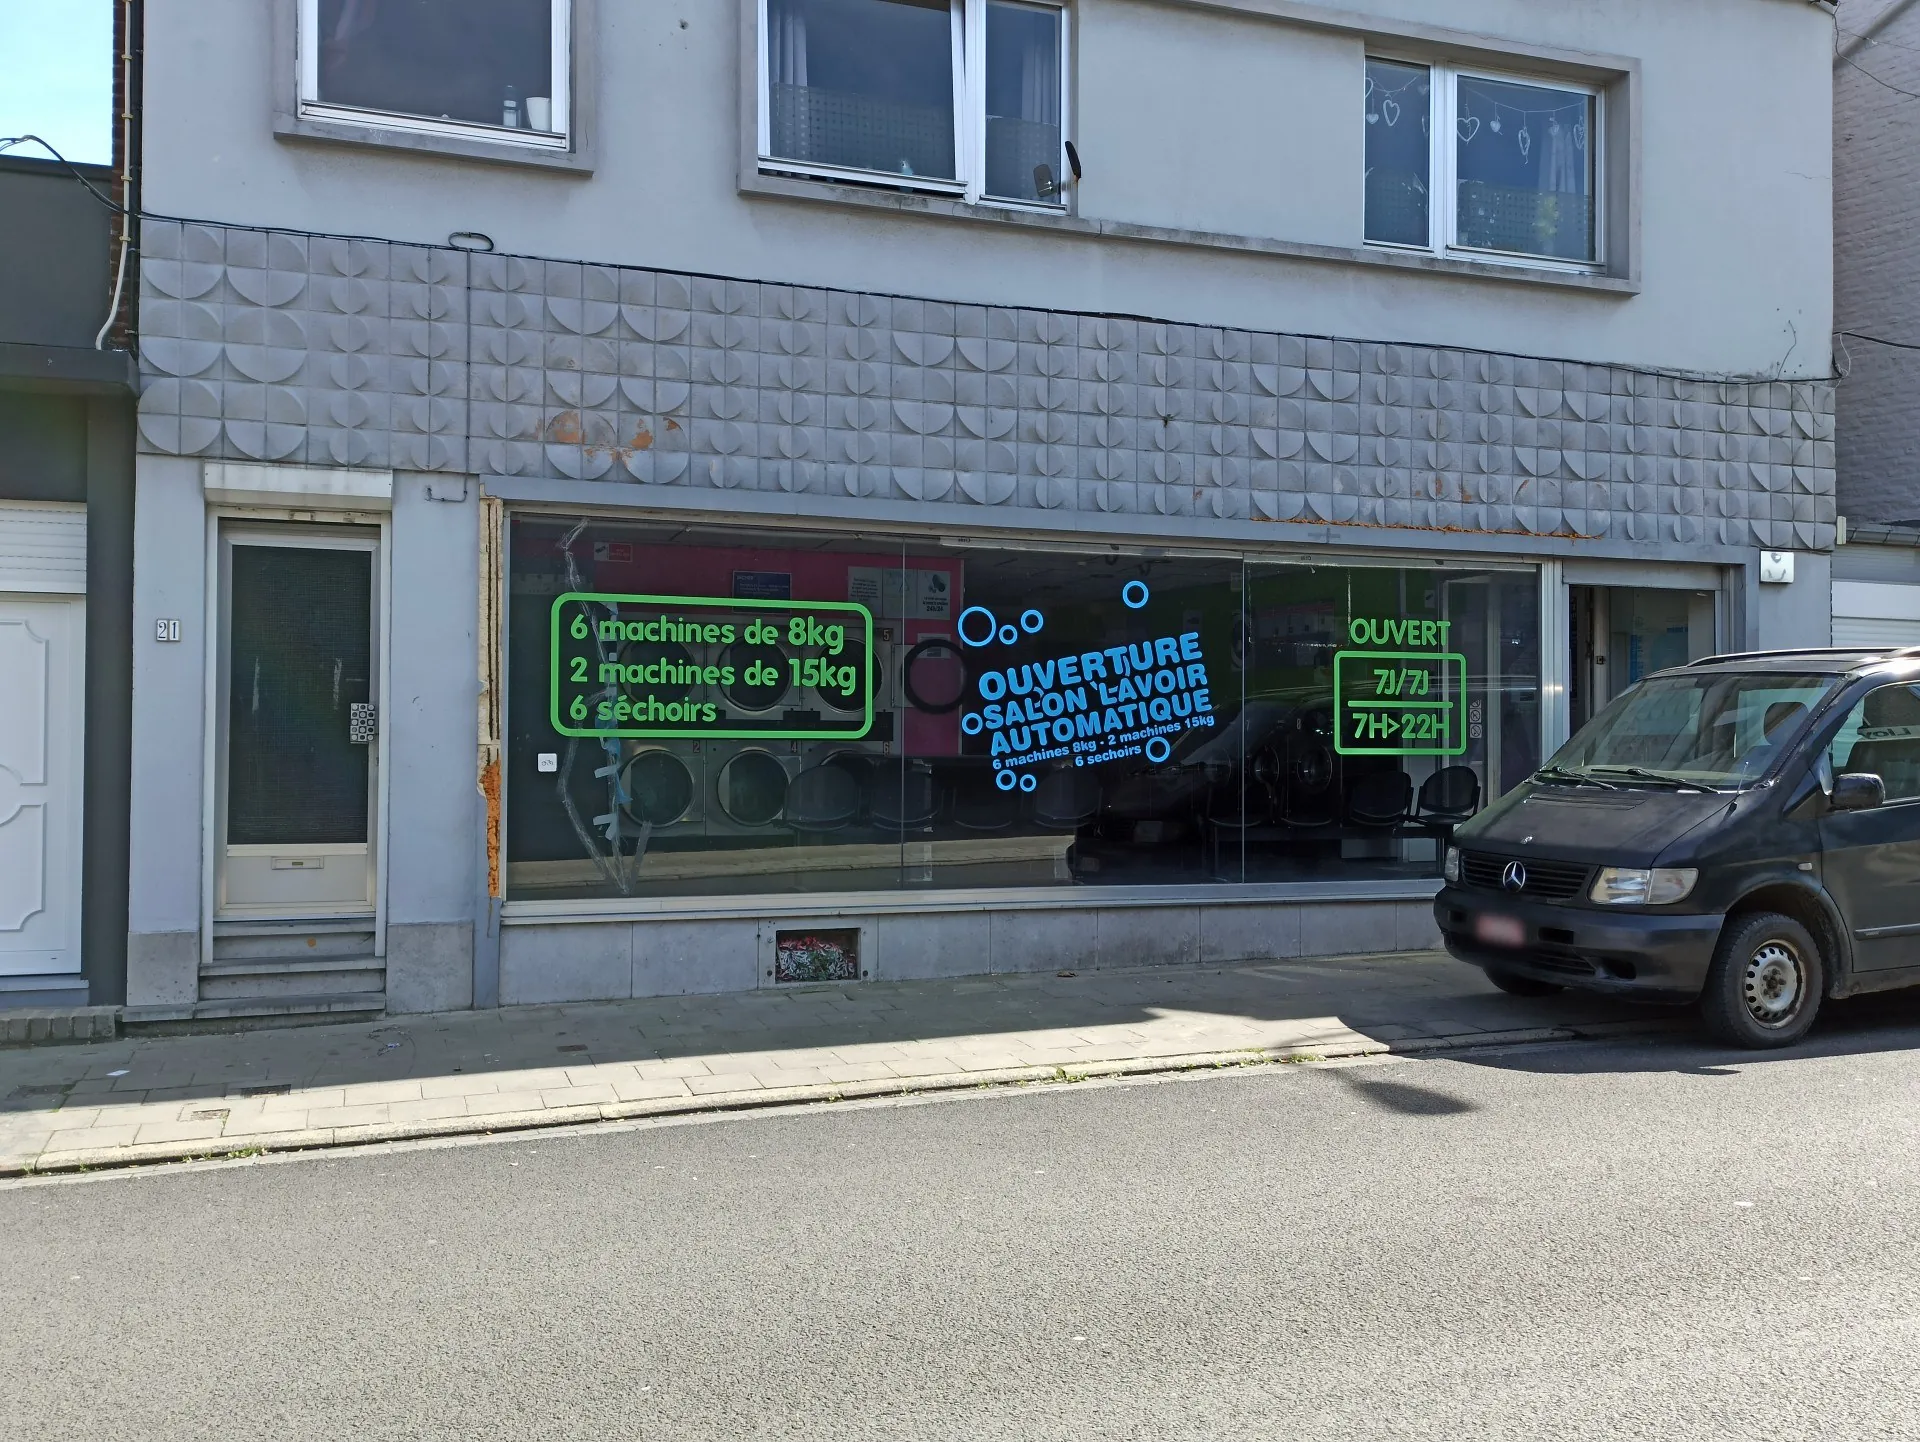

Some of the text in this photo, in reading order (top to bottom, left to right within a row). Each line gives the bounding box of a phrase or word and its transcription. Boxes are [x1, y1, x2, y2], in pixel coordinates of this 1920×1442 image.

[158, 621, 176, 639] 21
[570, 614, 844, 655] 6 machines de 8kg
[1349, 618, 1451, 646] OUVERT
[570, 656, 856, 696] 2 machines de 15kg
[978, 631, 1203, 701] OUVERTURE
[1373, 668, 1429, 696] 7J/7J
[569, 694, 717, 722] 6 séchoirs
[982, 663, 1208, 730] SALON LAVOIR
[990, 688, 1213, 757] AUTOMATIQUE
[1352, 712, 1450, 739] 7H>22H
[992, 759, 1002, 770] 6
[1005, 746, 1069, 768] machines
[1073, 739, 1097, 754] 8kg
[1108, 734, 1116, 745] 2
[1119, 723, 1181, 742] machines
[1185, 714, 1215, 730] 15kg
[1075, 745, 1142, 767] 6 sechoirs
